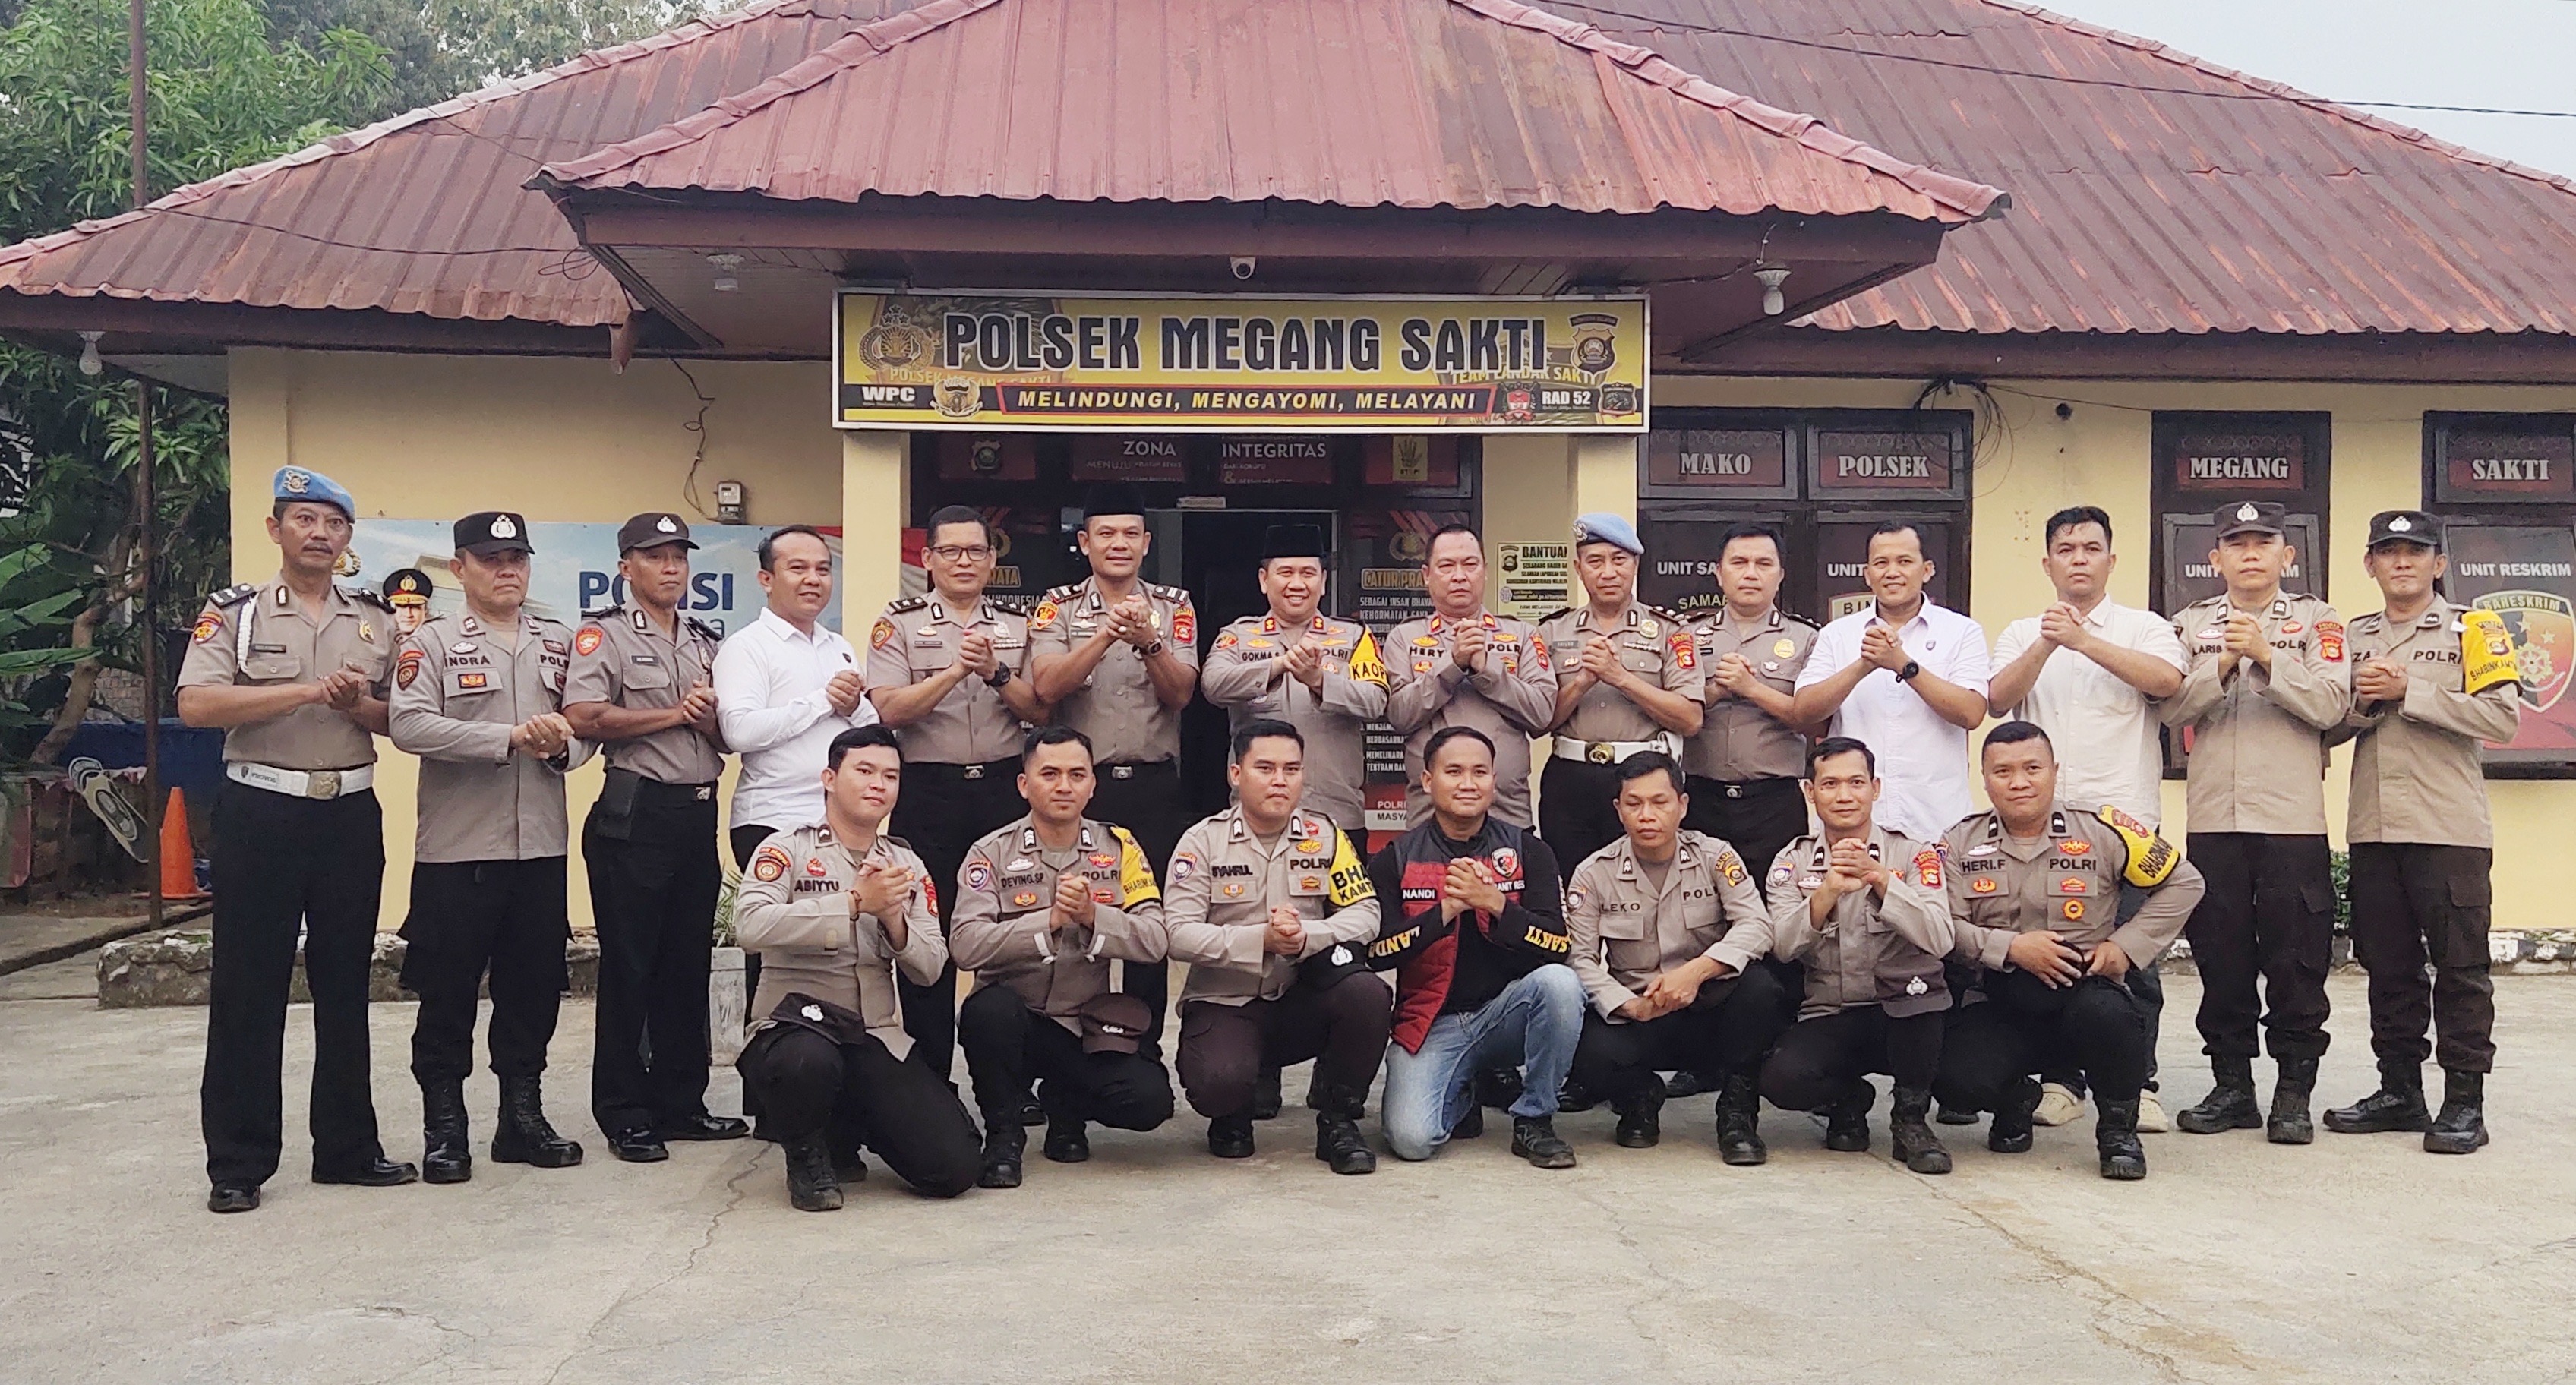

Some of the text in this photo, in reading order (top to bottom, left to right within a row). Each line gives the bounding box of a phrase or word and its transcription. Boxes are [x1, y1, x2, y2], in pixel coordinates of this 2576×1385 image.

[945, 313, 1546, 372] POLSEK MEGANG SAKTI
[863, 386, 915, 402] WPC
[1018, 390, 1476, 412] MELINDUNGI, MENGAYOMI, MELAYANI
[1542, 391, 1570, 405] RAD
[1573, 390, 1591, 405] 52
[1123, 440, 1327, 458] ZONA INTEGRITAS
[1680, 453, 2549, 481] MAKO POLSEK MEGANG SAKTI
[1657, 561, 1717, 575] UNIT SA
[1827, 563, 1867, 576] UNIT
[2460, 563, 2571, 576] UNIT RESKRIM
[1364, 570, 1397, 588] CATUR
[1360, 597, 1387, 606] SEBAGAI
[1390, 597, 1410, 606] INSAN
[2483, 595, 2560, 611] BARESKRIM
[1360, 610, 1407, 620] KEHORMATAN
[1322, 648, 1348, 660] OLRI
[1410, 643, 1520, 658] HERY POLR
[2413, 651, 2461, 664] POLRI
[445, 655, 569, 669] INDRA POLR
[1962, 858, 2096, 872] HERI.F POLRI
[794, 880, 839, 892] ABIYYU
[1494, 881, 1512, 891] ANIT
[1403, 889, 1435, 899] NANDI
[1683, 886, 1719, 901] POL
[1601, 902, 1640, 911] LEKO
